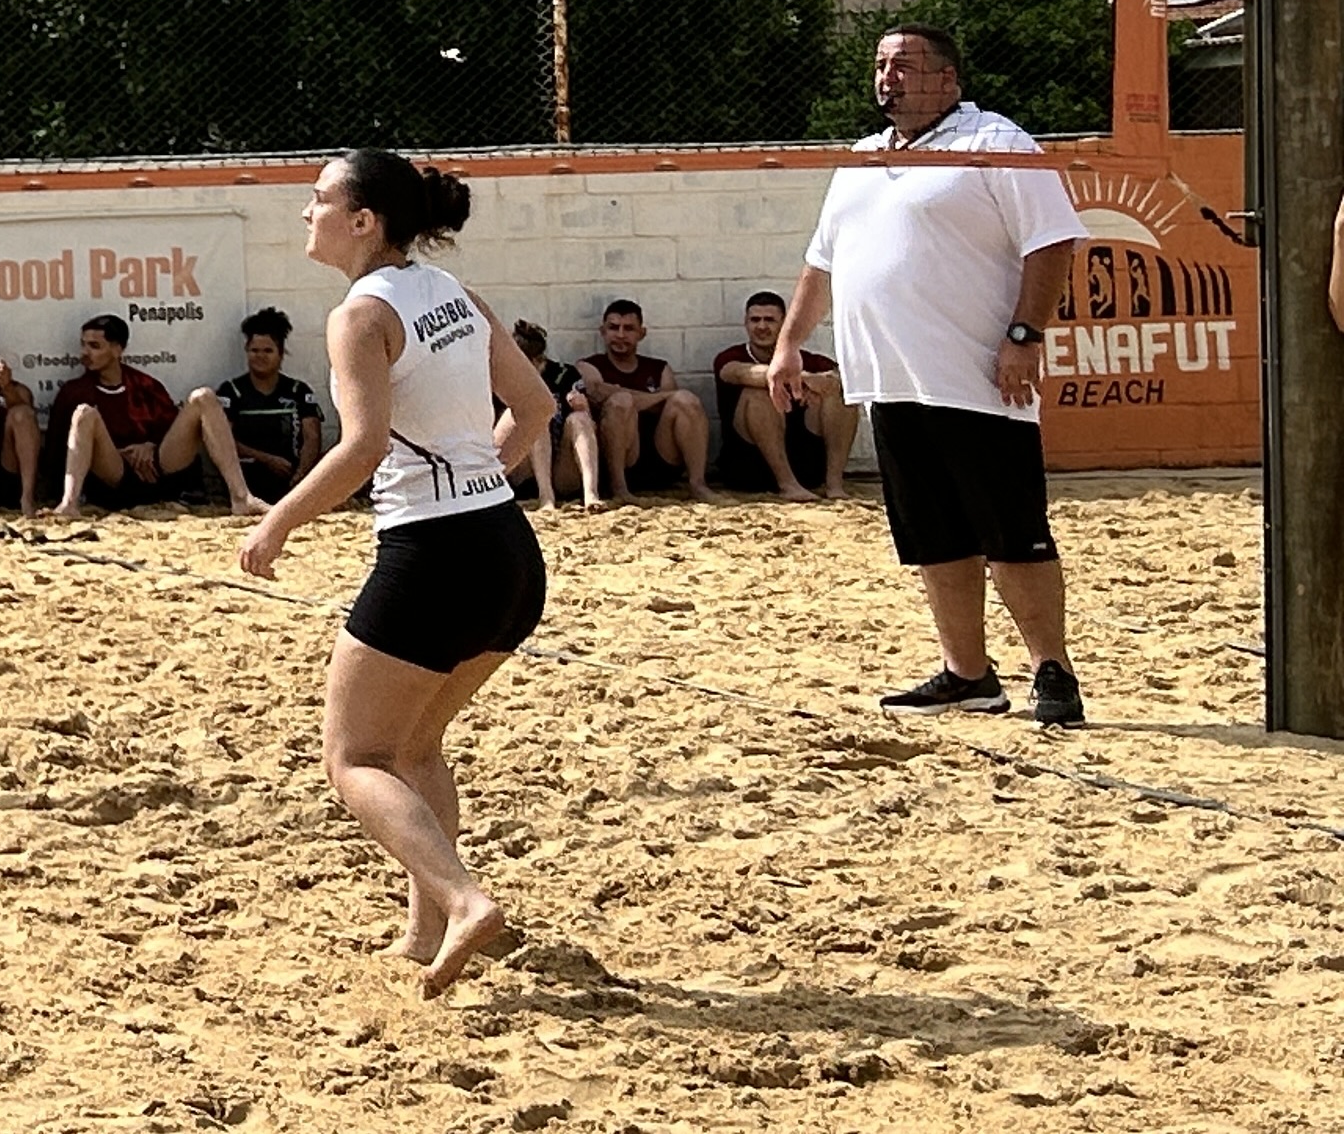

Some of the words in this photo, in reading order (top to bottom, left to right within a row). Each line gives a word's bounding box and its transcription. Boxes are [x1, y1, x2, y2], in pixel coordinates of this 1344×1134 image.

[88, 246, 201, 299] Park
[128, 301, 205, 325] Penápolis
[1044, 321, 1237, 376] ENAFUT
[1058, 380, 1164, 407] BEACH
